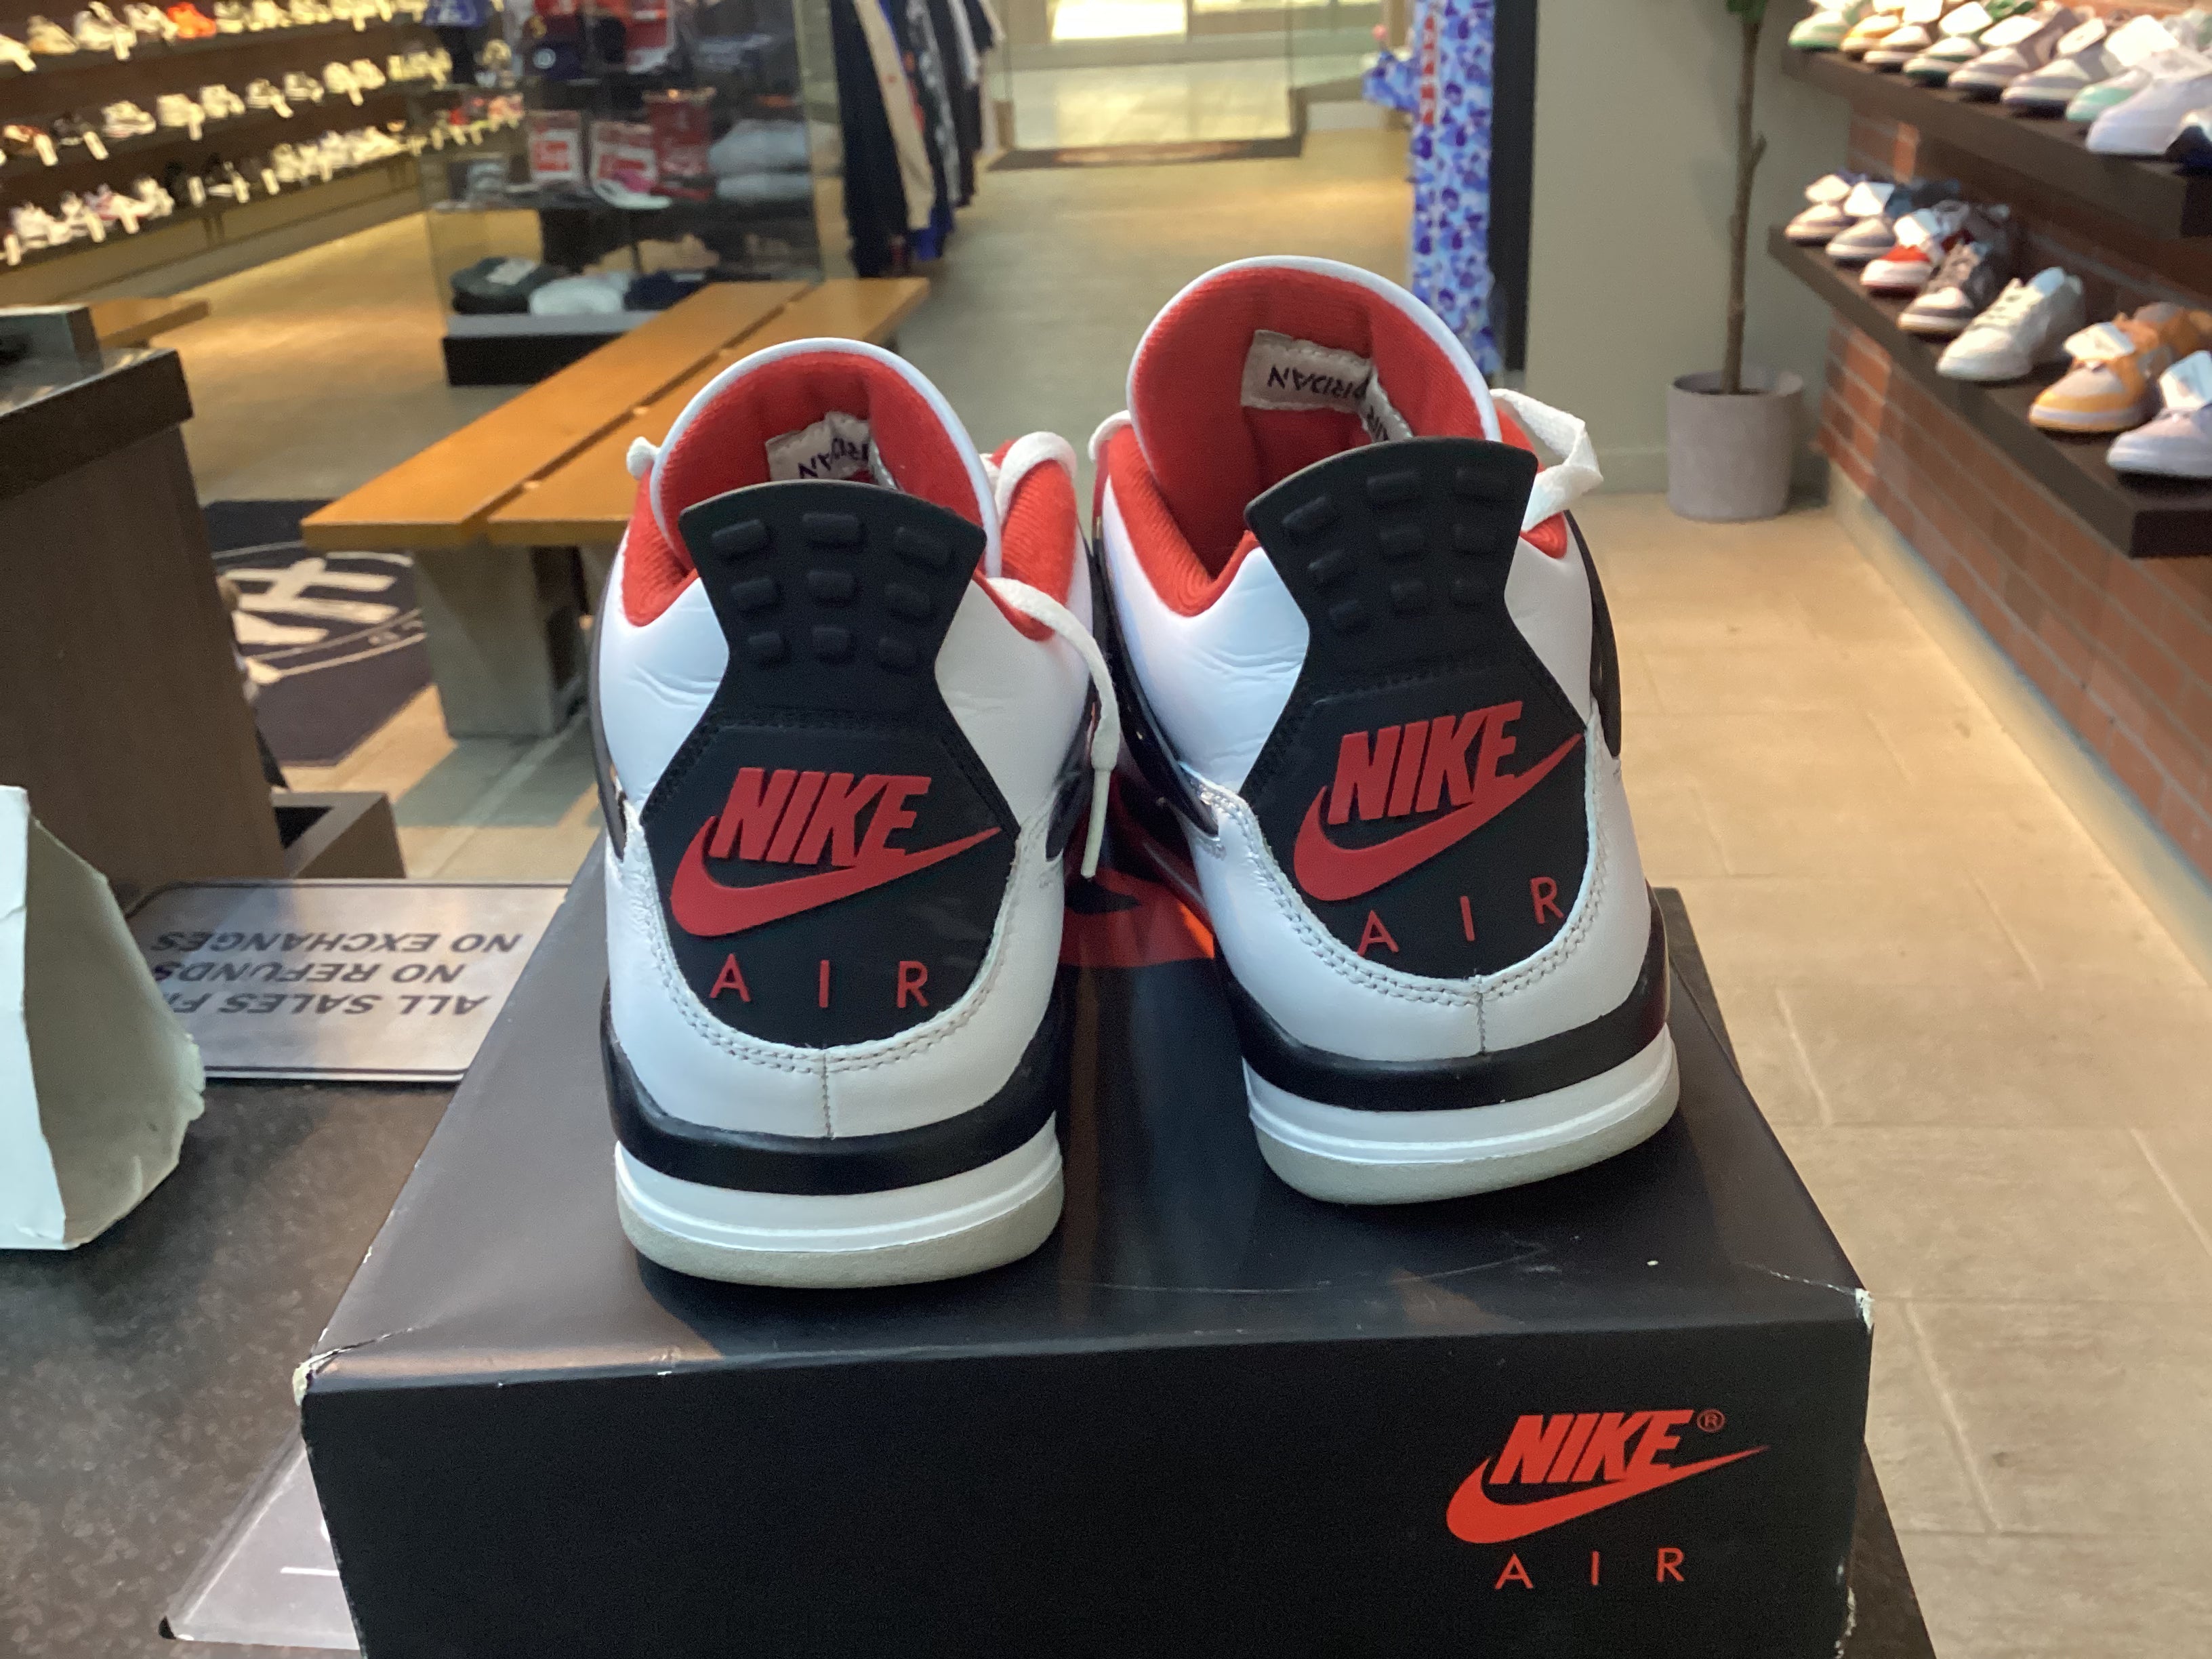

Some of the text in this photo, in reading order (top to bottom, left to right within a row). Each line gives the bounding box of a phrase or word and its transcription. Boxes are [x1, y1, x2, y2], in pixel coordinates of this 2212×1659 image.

[1327, 700, 1523, 825] NIKE
[708, 766, 931, 868] NIKE
[150, 931, 523, 953] NO EXCHANGES
[152, 961, 466, 983] NO REFUNDS
[218, 993, 382, 1015] SALES
[398, 994, 491, 1015] ALL
[1495, 1547, 1685, 1590] AIR
